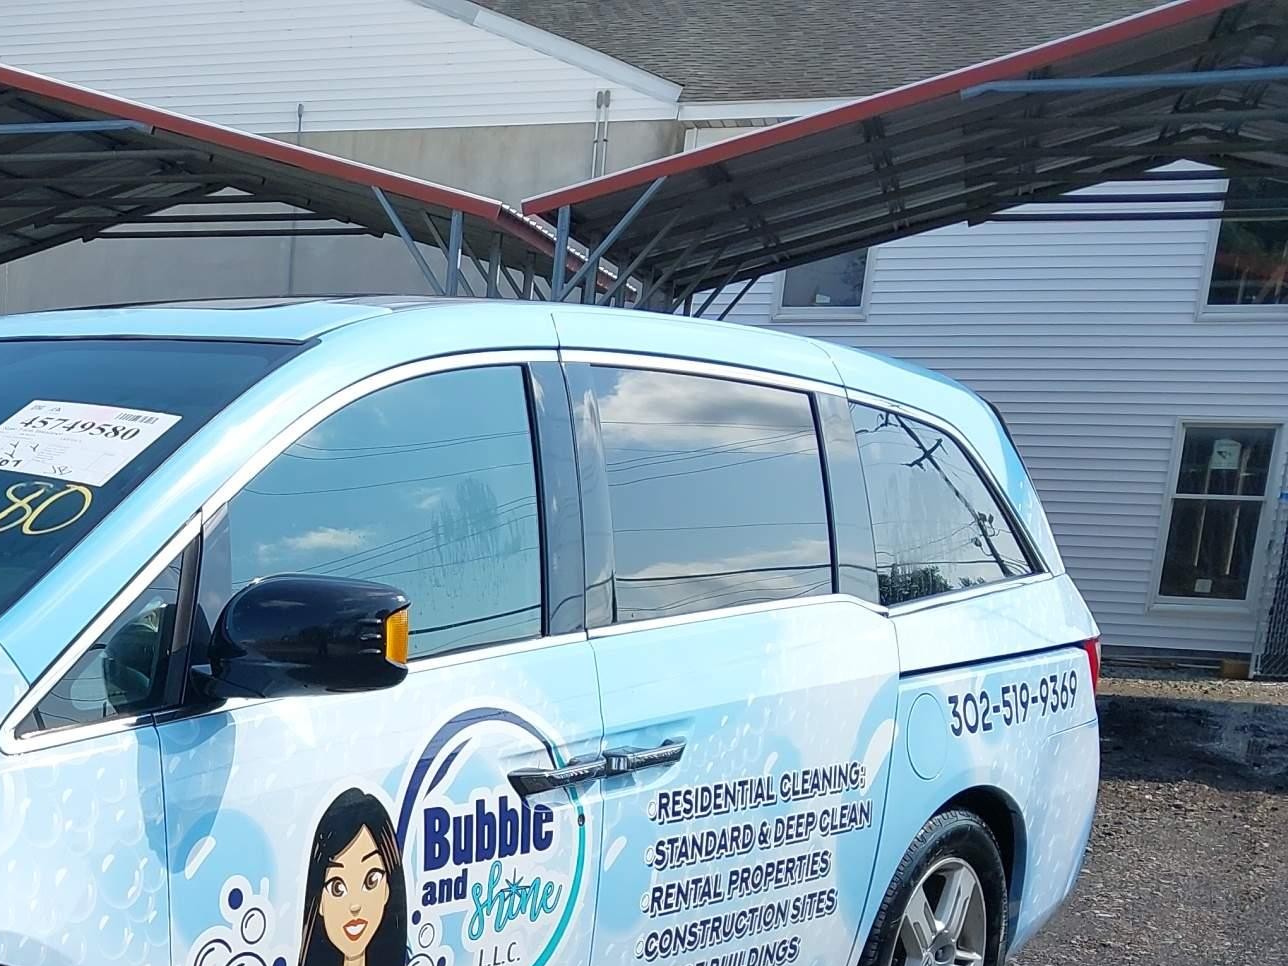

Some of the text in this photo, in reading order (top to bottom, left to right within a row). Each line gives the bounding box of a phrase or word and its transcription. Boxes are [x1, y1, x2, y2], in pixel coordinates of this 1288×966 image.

[20, 416, 140, 441] 45749580
[947, 669, 1078, 737] 302-519-9369
[422, 795, 555, 872] Bubble
[657, 775, 777, 825] RESIDENTIAL
[653, 800, 873, 871] STANDARD & DEEP CLEAN
[421, 859, 562, 941] and shine
[649, 849, 832, 919] RENTAL PROPERTIES
[643, 887, 838, 962] CONSTRUCTION SITES
